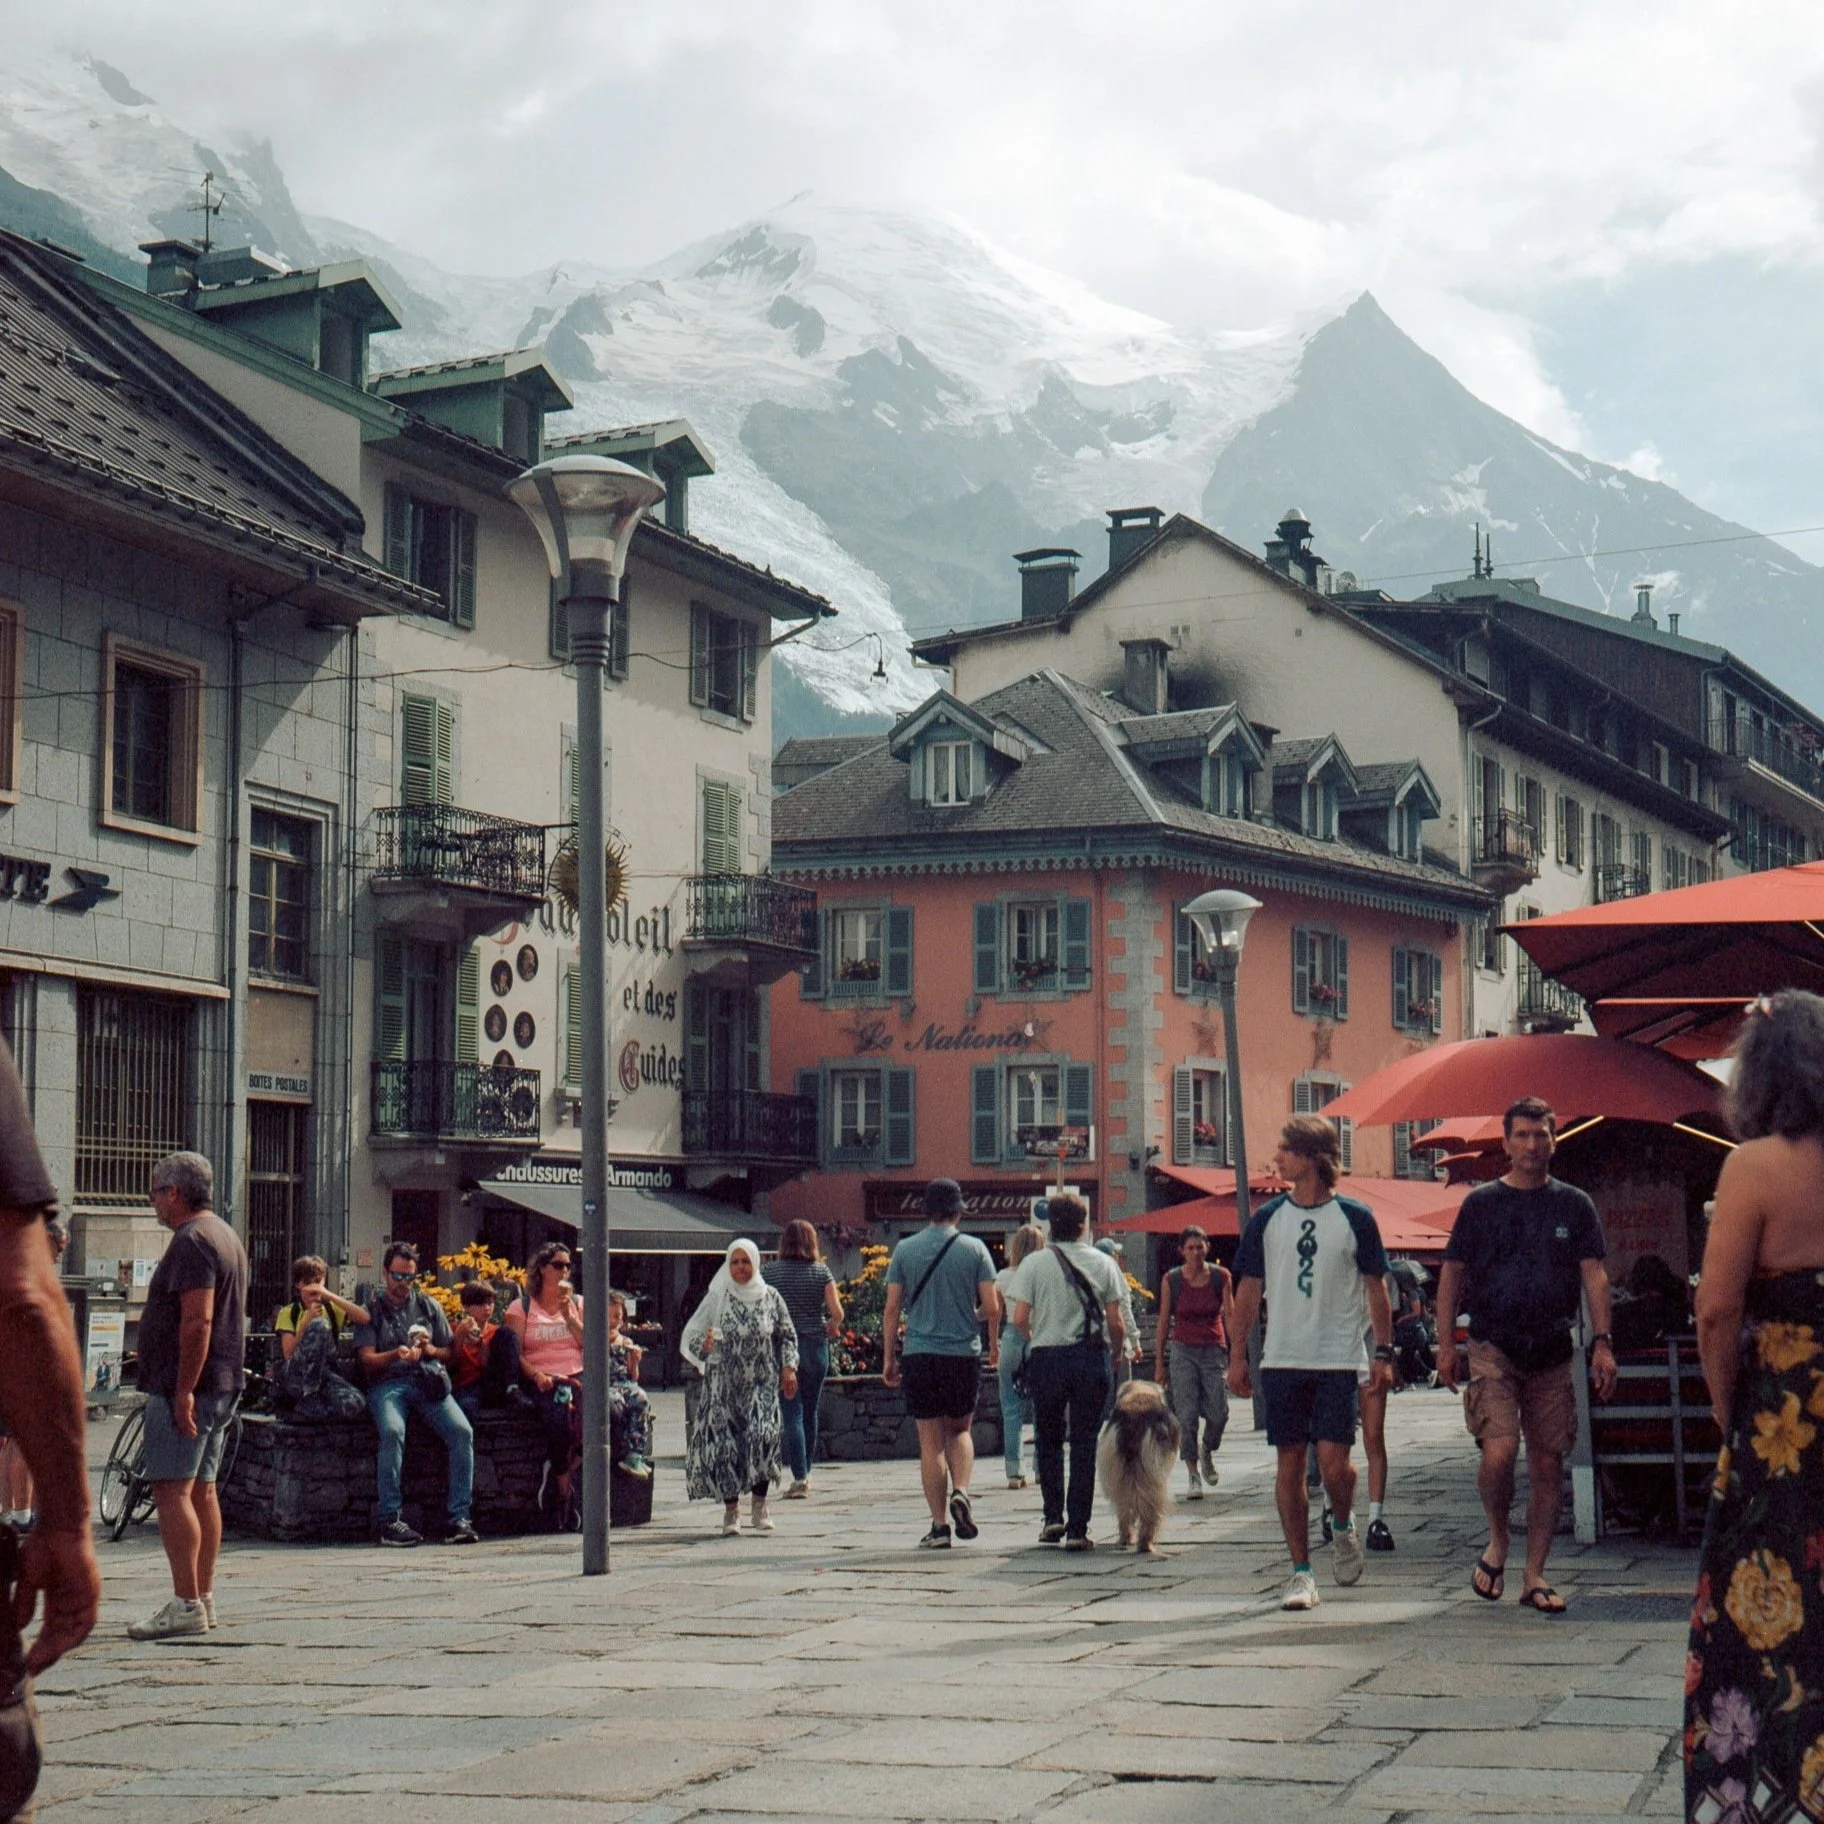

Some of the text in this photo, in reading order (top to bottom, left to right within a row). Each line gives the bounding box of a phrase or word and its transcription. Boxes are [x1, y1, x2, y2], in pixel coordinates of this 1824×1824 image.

[606, 898, 673, 957] oleil
[623, 979, 677, 1021] et des
[275, 1076, 308, 1093] POSTALES
[607, 1164, 672, 1188] Armando
[966, 1194, 1031, 1210] ation
